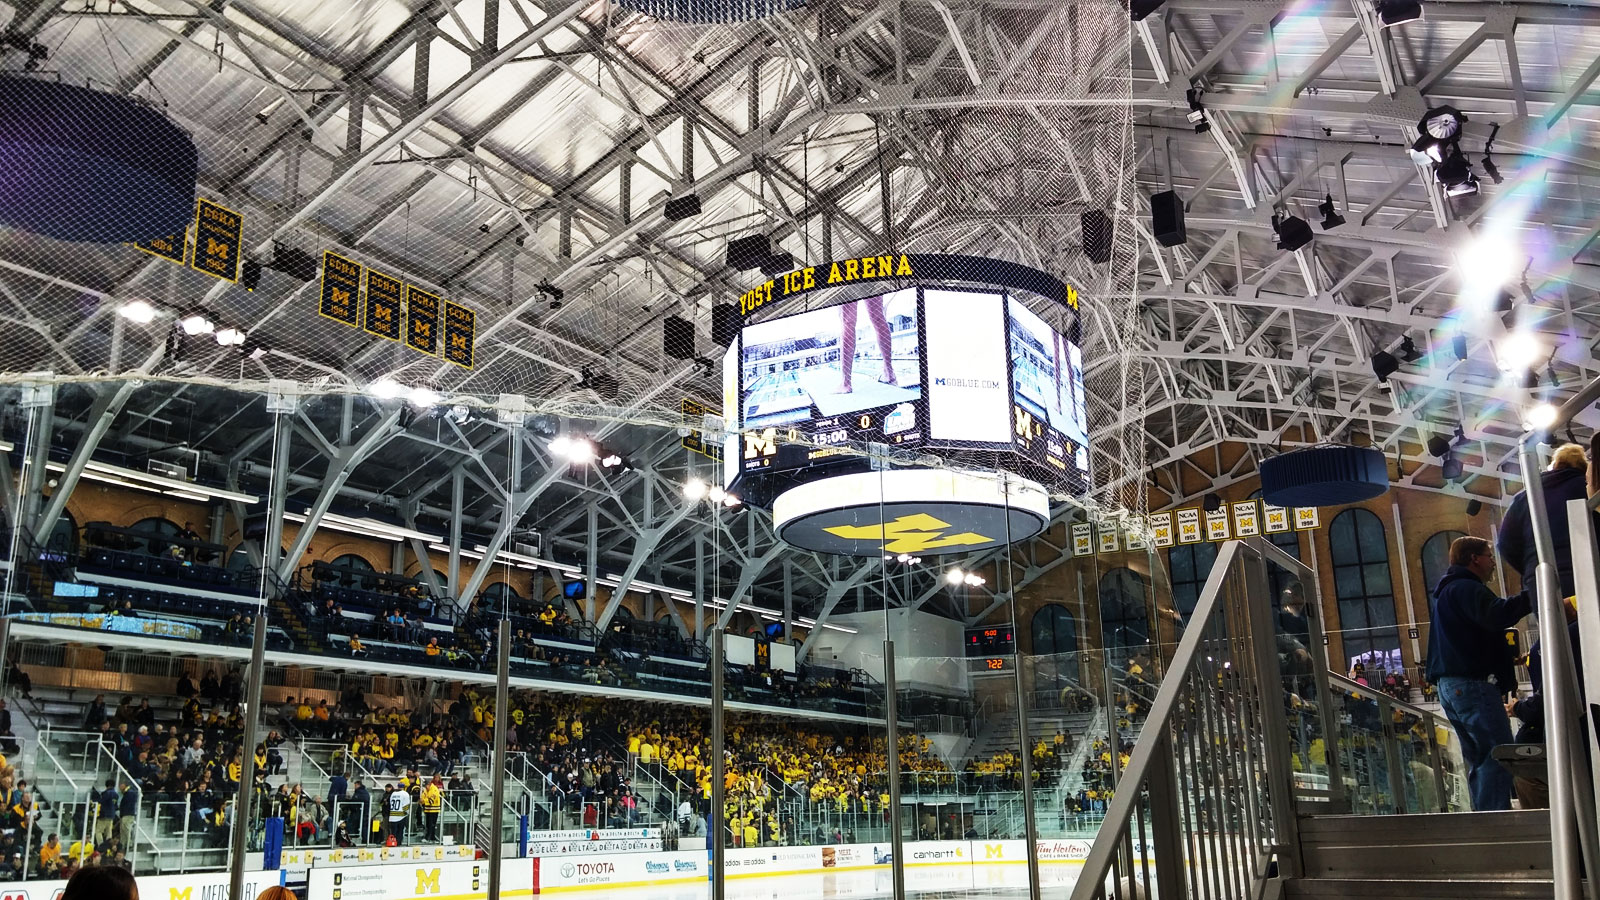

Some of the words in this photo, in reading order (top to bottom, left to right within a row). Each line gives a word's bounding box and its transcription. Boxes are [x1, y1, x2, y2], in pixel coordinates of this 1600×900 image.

[204, 207, 236, 228] CCHA
[206, 237, 229, 259] M
[738, 280, 774, 316] YOST
[783, 267, 816, 295] ICE
[827, 253, 913, 284] ARENA
[331, 286, 350, 306] M
[1066, 283, 1078, 310] M
[375, 303, 392, 322] M
[415, 319, 431, 337] M
[451, 332, 466, 350] M
[860, 415, 870, 428] 0
[1014, 405, 1033, 441] M
[788, 429, 797, 442] 0
[812, 430, 847, 445] 15:00
[745, 428, 777, 459] M
[1269, 513, 1282, 523] M
[1299, 509, 1313, 519] M
[1183, 524, 1195, 534] M
[1211, 521, 1224, 531] M
[1240, 518, 1253, 527] M
[1102, 534, 1114, 544] M
[1155, 528, 1168, 538] M
[1077, 538, 1088, 547] M
[758, 643, 767, 656] M
[390, 799, 400, 810] 30
[984, 843, 1003, 859] M
[1036, 842, 1051, 853] Tim
[1053, 842, 1086, 853] Hortons
[913, 850, 954, 859] carhartt
[577, 862, 615, 875] TOYOTA
[725, 859, 741, 867] adidas
[414, 868, 441, 894] M
